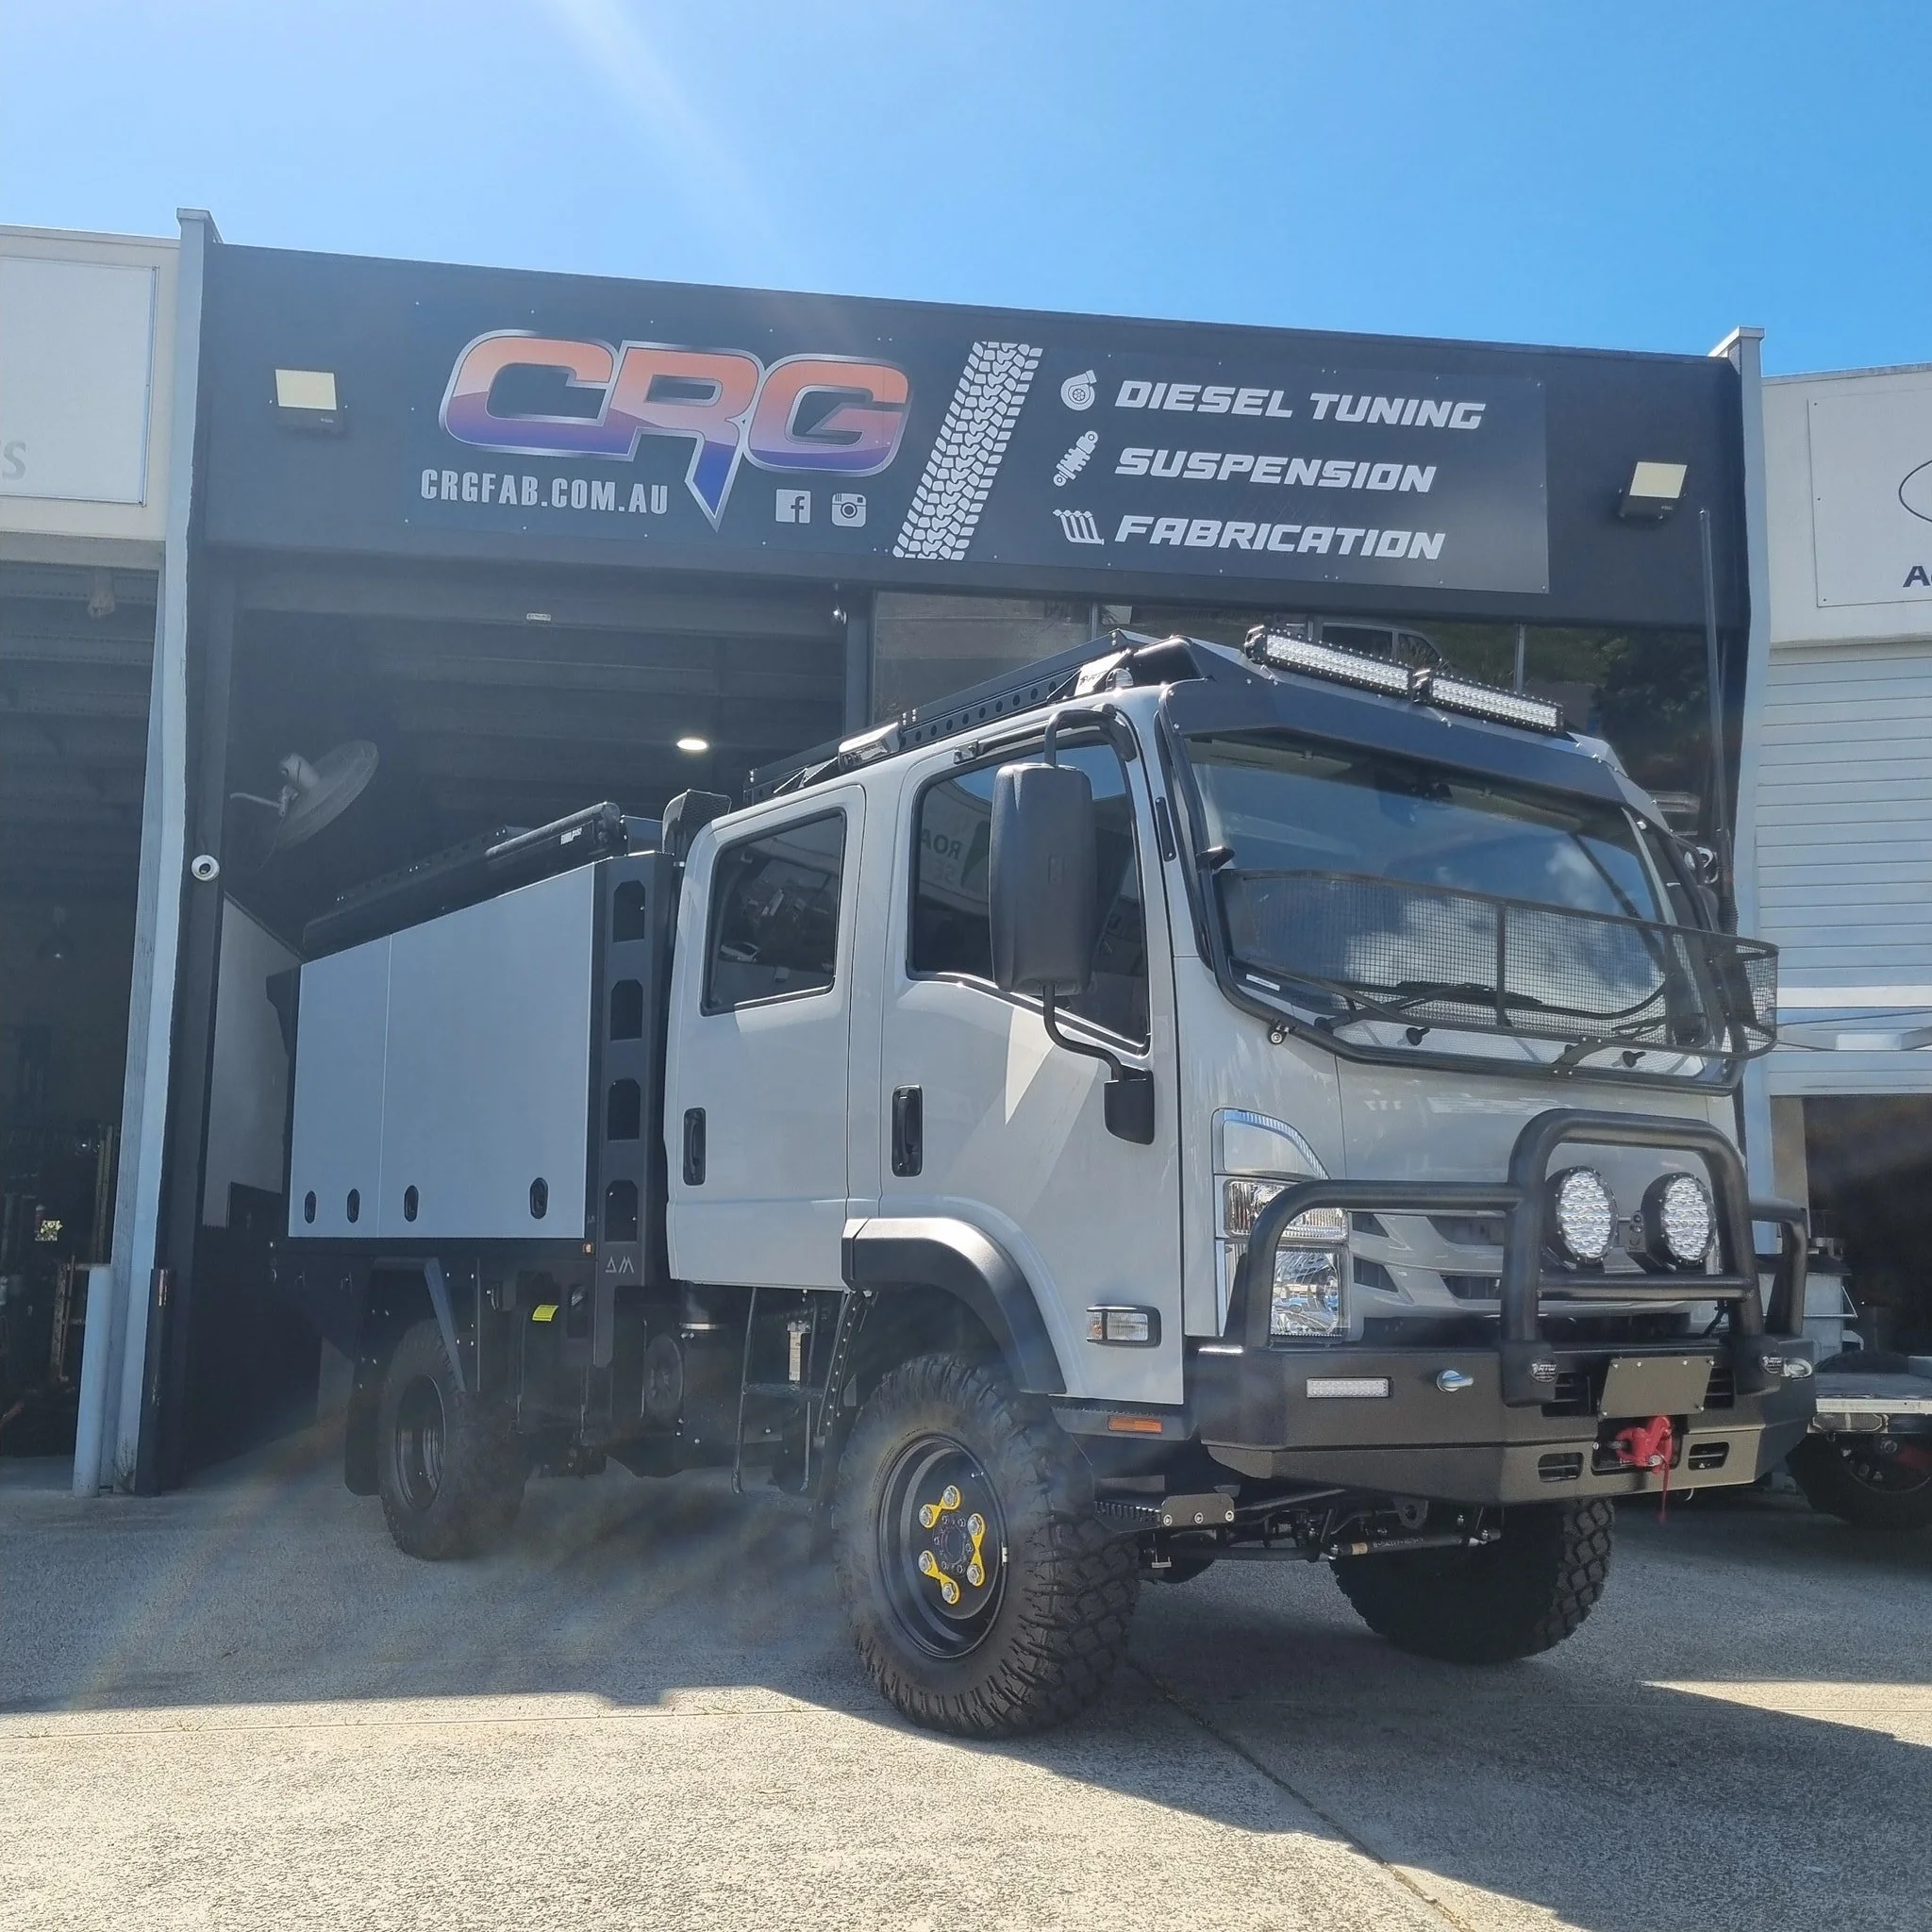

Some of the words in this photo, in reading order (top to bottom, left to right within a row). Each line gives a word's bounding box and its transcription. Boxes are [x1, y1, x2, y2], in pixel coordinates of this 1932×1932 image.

[1115, 380, 1292, 418] DIESEL
[1310, 393, 1487, 429] TUNING
[439, 328, 911, 533] CRG
[0, 440, 26, 481] S
[1115, 448, 1437, 492] SUSPENSION
[420, 468, 668, 516] CRGFAB.COM.AU
[1115, 515, 1445, 559] FABRICATION
[1902, 565, 1932, 588] A
